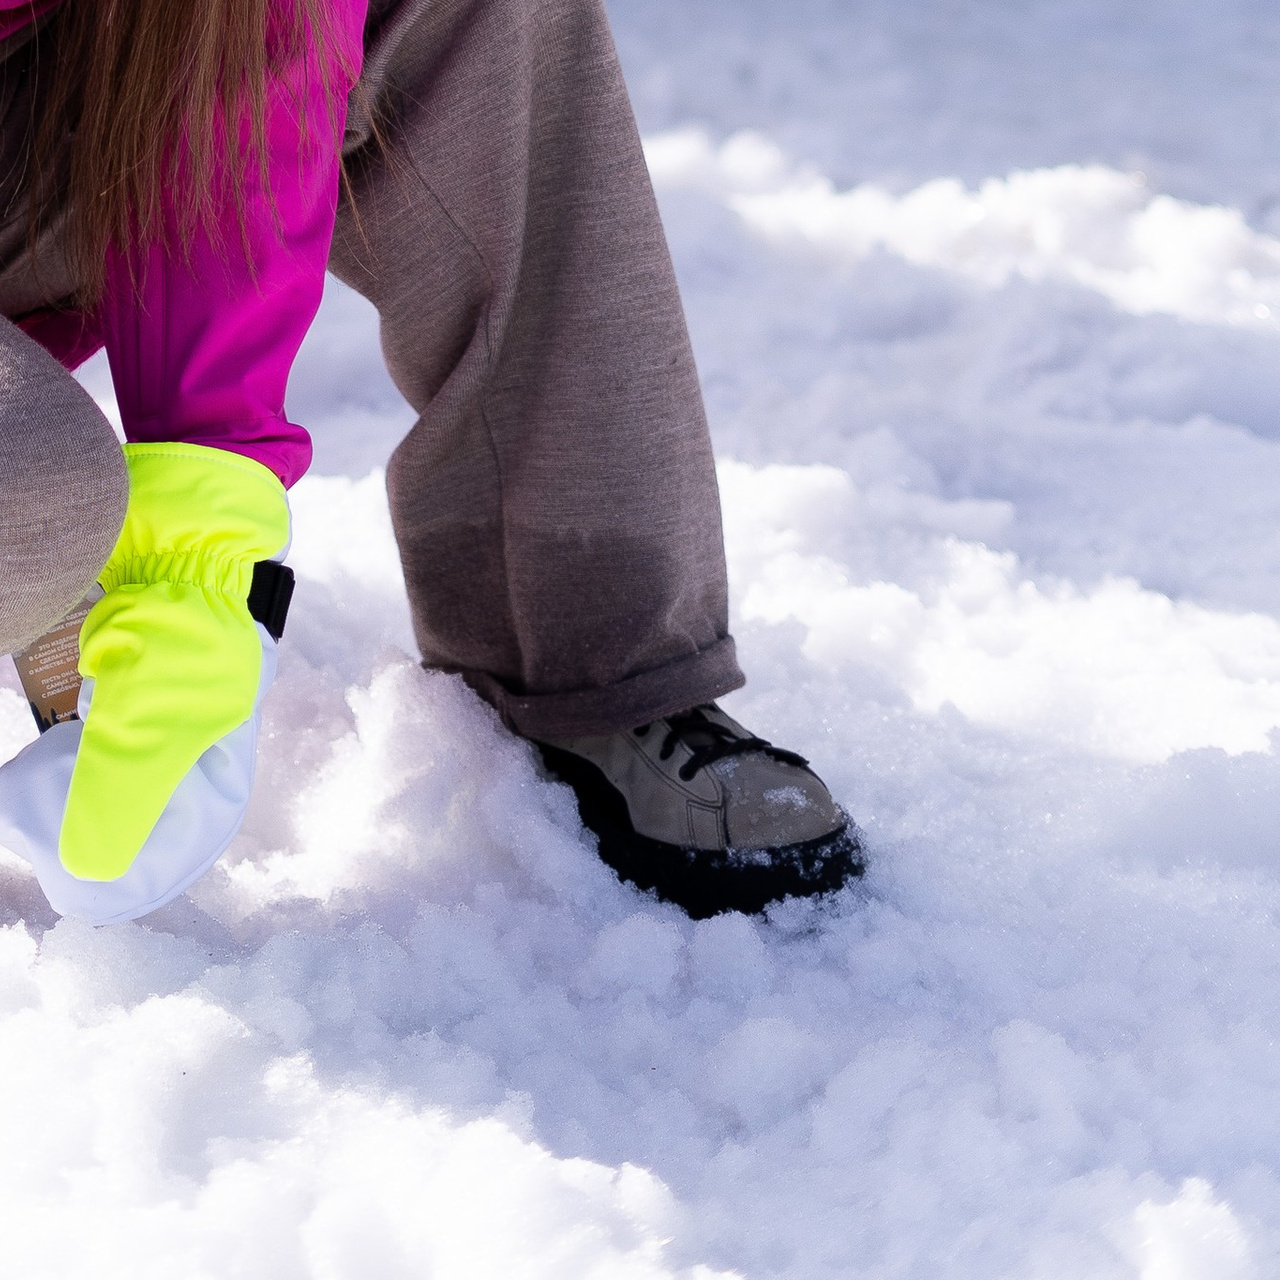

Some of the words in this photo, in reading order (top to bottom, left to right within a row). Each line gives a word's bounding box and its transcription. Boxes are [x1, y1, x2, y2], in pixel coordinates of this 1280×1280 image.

[66, 609, 90, 621] ОДЕЖД
[34, 648, 57, 660] САМОМ
[57, 640, 78, 652] СЕРДЦ
[40, 651, 68, 664] СДЕЛАНО
[41, 675, 61, 685] ПУСТЬ
[61, 669, 75, 678] ОНА
[56, 708, 77, 720] СКАНИ
